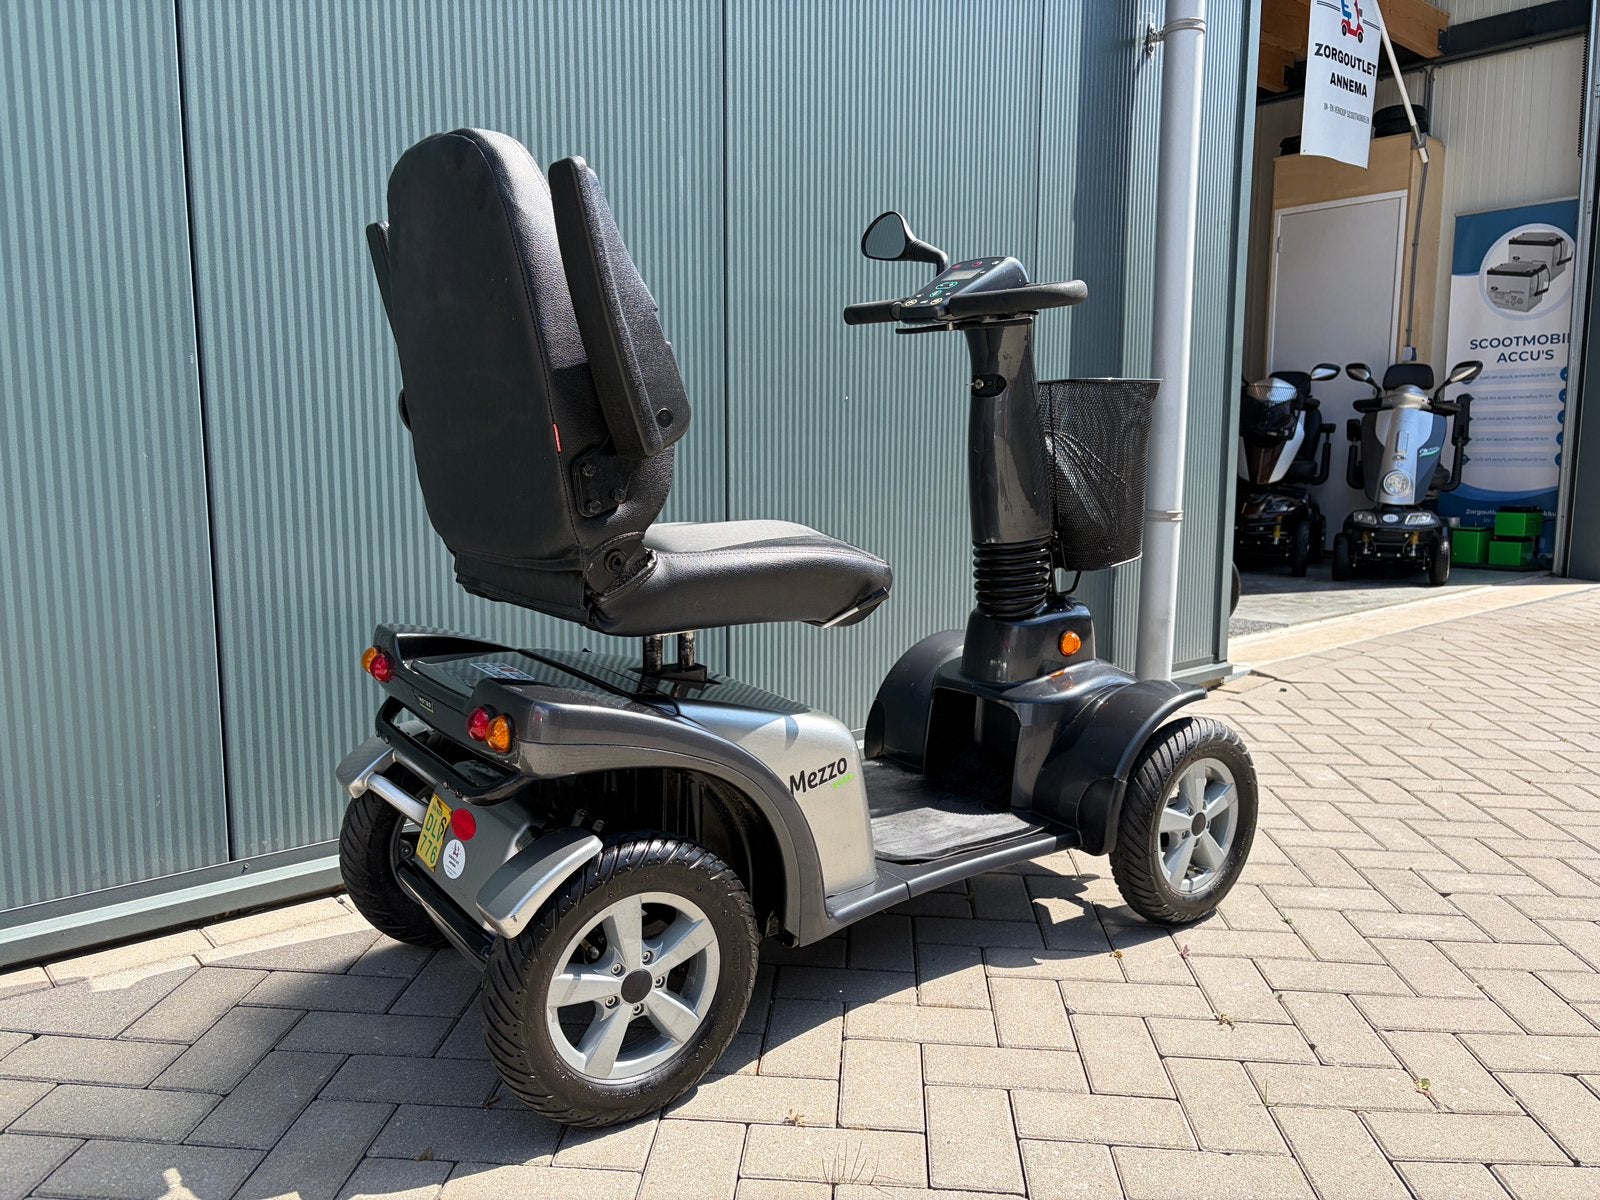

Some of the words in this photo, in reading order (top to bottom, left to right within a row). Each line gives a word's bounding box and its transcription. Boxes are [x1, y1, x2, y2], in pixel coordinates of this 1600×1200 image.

[1314, 42, 1377, 77] ZORGOUTLET
[1330, 72, 1368, 98] ANNEMA
[1470, 332, 1570, 350] SCOOTMOBI
[1496, 349, 1555, 363] ACCU'S
[789, 757, 848, 795] Mezzo
[419, 834, 438, 864] 776
